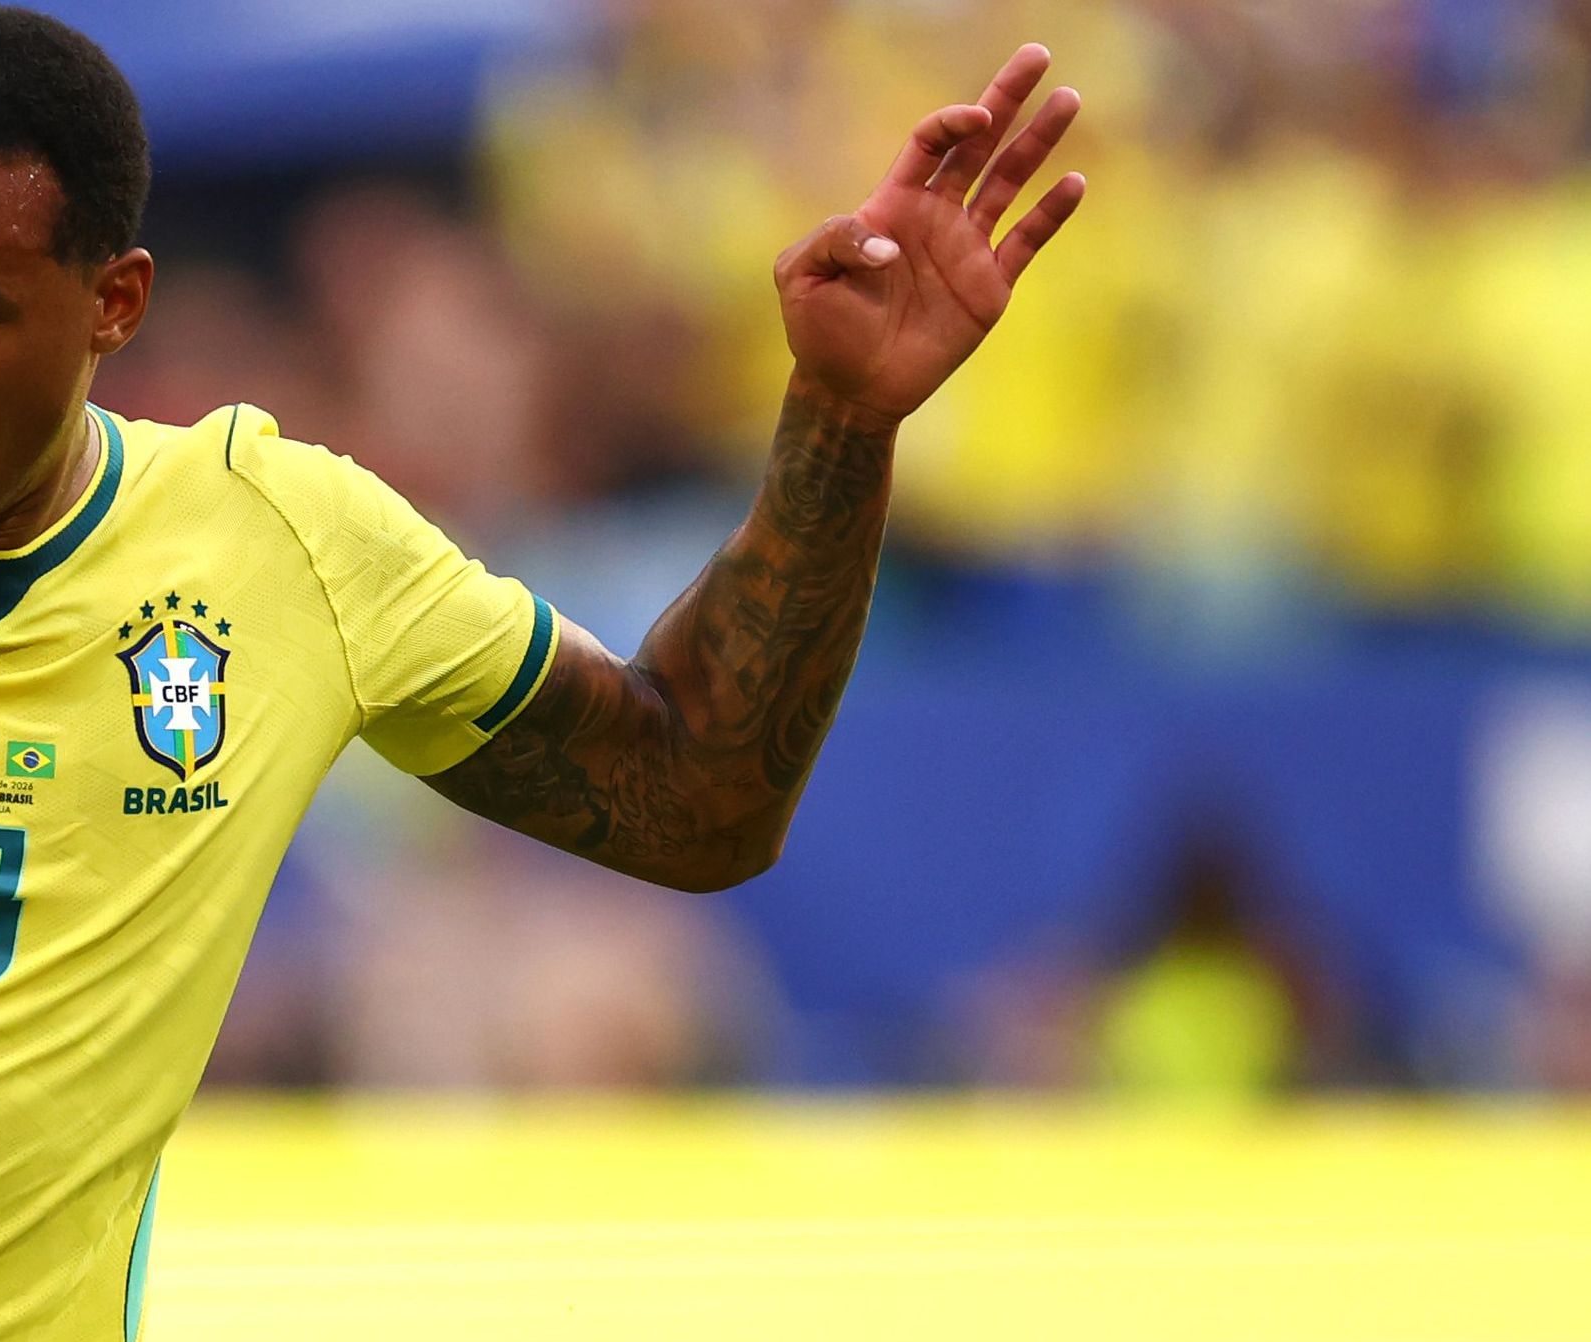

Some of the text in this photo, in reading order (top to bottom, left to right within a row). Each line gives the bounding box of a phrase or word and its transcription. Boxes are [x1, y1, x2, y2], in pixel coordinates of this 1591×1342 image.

[162, 685, 199, 703] CBF
[11, 781, 33, 790] 2026
[0, 792, 34, 805] BRASIL
[123, 781, 228, 815] BRASIL
